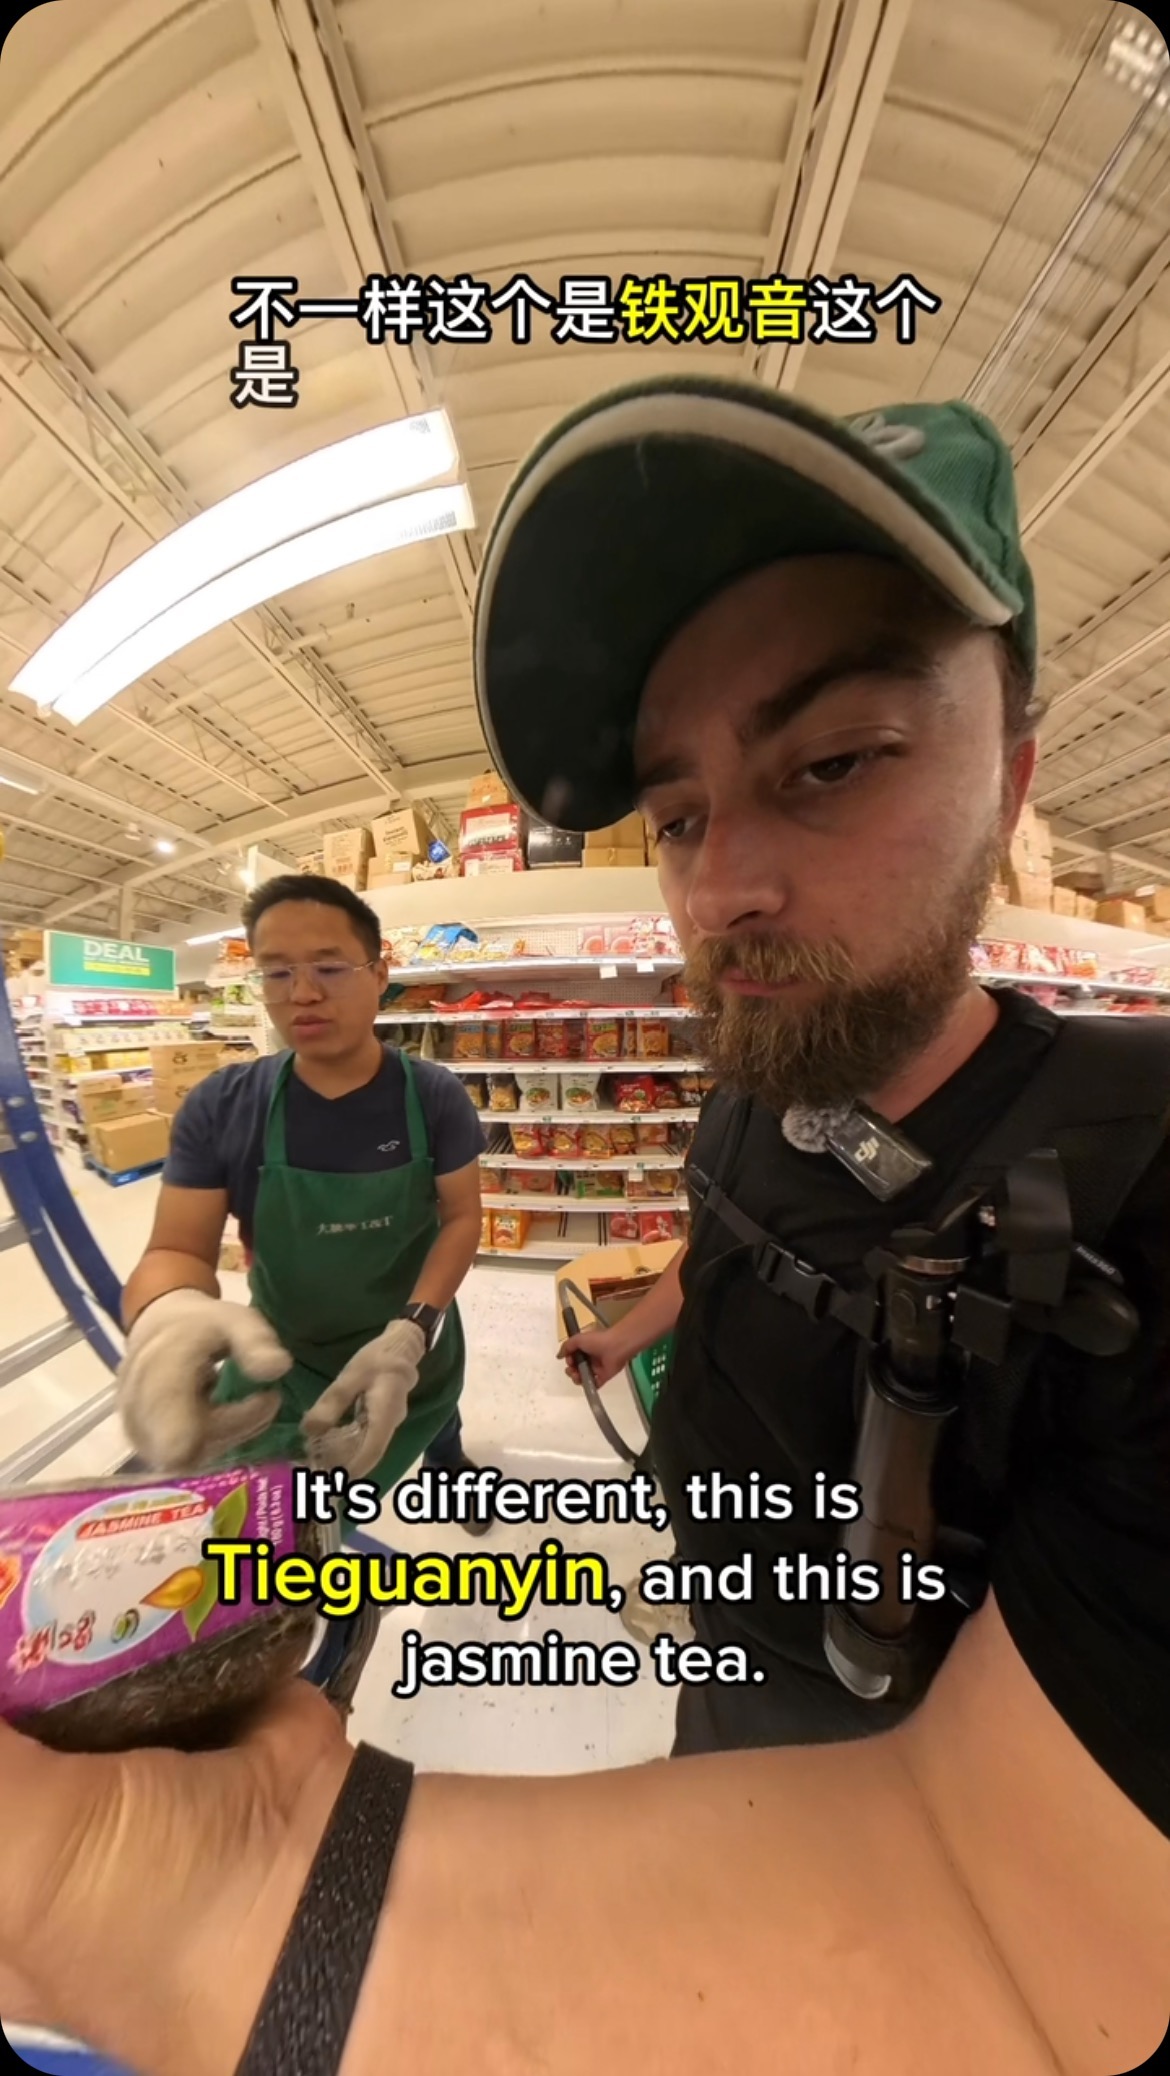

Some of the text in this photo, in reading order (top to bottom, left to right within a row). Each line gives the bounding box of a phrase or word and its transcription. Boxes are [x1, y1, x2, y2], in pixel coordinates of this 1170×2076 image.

[83, 940, 150, 962] DEAL
[87, 1512, 162, 1536] JASMINE
[172, 1503, 206, 1519] TEA
